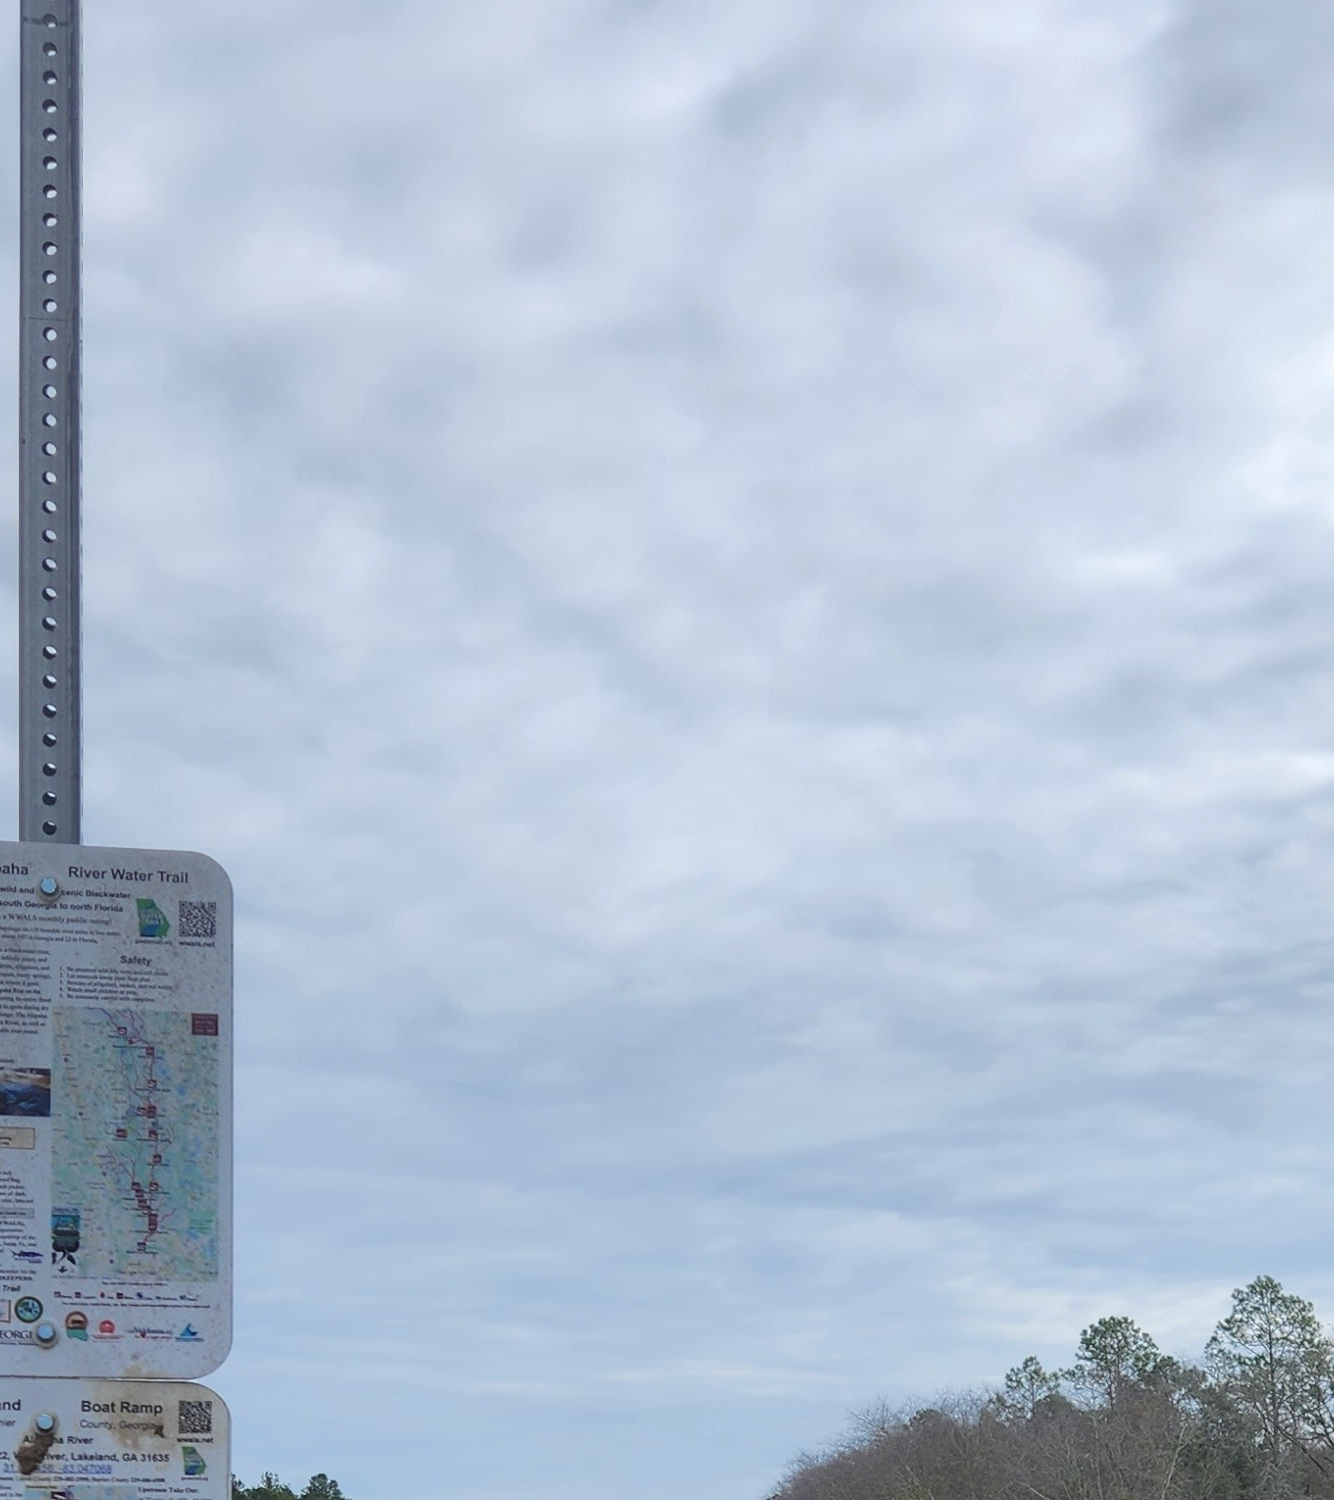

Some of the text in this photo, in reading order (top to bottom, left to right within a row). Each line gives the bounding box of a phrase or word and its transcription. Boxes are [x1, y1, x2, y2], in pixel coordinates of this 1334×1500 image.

[68, 866, 189, 884] River Water Trail
[0, 883, 17, 894] wild
[19, 886, 35, 895] and
[61, 889, 131, 899] cenic Blackwater
[25, 901, 57, 910] Georgia
[70, 903, 93, 911] north
[94, 903, 124, 912] Florida
[120, 955, 152, 966] Safety
[3, 1285, 21, 1293] Trail
[81, 1400, 163, 1416] Boat Ramp
[80, 1420, 160, 1432] County, Georgia
[67, 1436, 94, 1444] River
[71, 1453, 120, 1463] Lakeland,
[122, 1453, 139, 1462] GA
[140, 1453, 170, 1463] 31635
